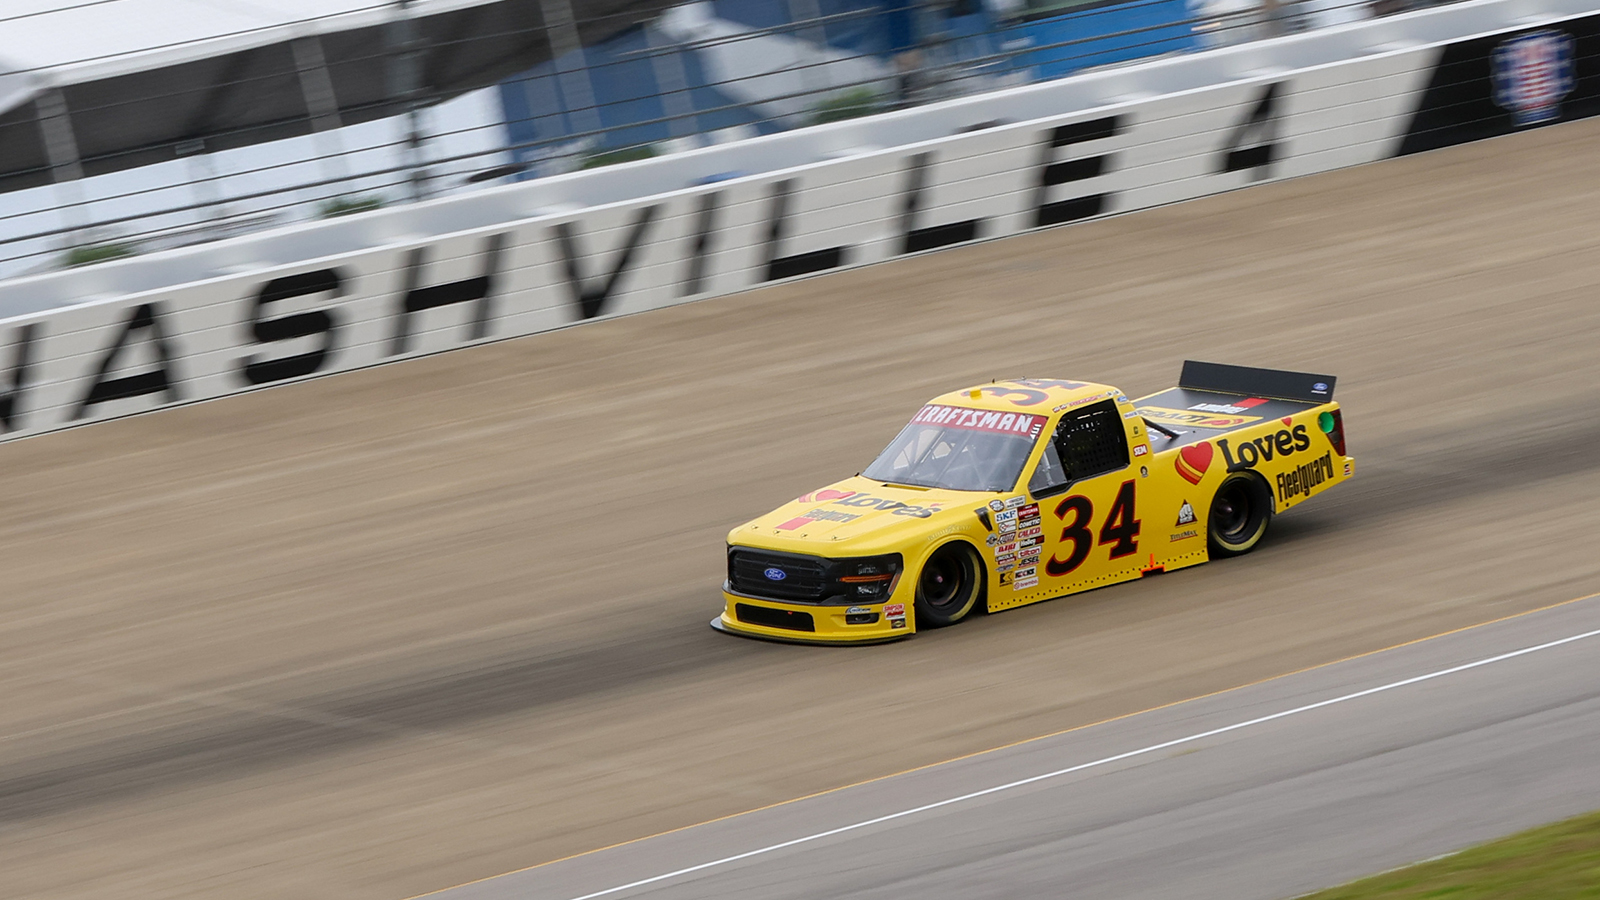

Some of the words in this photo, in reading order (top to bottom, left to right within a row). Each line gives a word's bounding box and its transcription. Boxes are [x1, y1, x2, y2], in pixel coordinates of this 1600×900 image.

[915, 405, 1033, 433] CRAFTSMAN
[1276, 450, 1334, 502] Fleetguard
[996, 510, 1016, 522] SKF
[1045, 479, 1142, 577] 34
[1020, 548, 1040, 556] tilton
